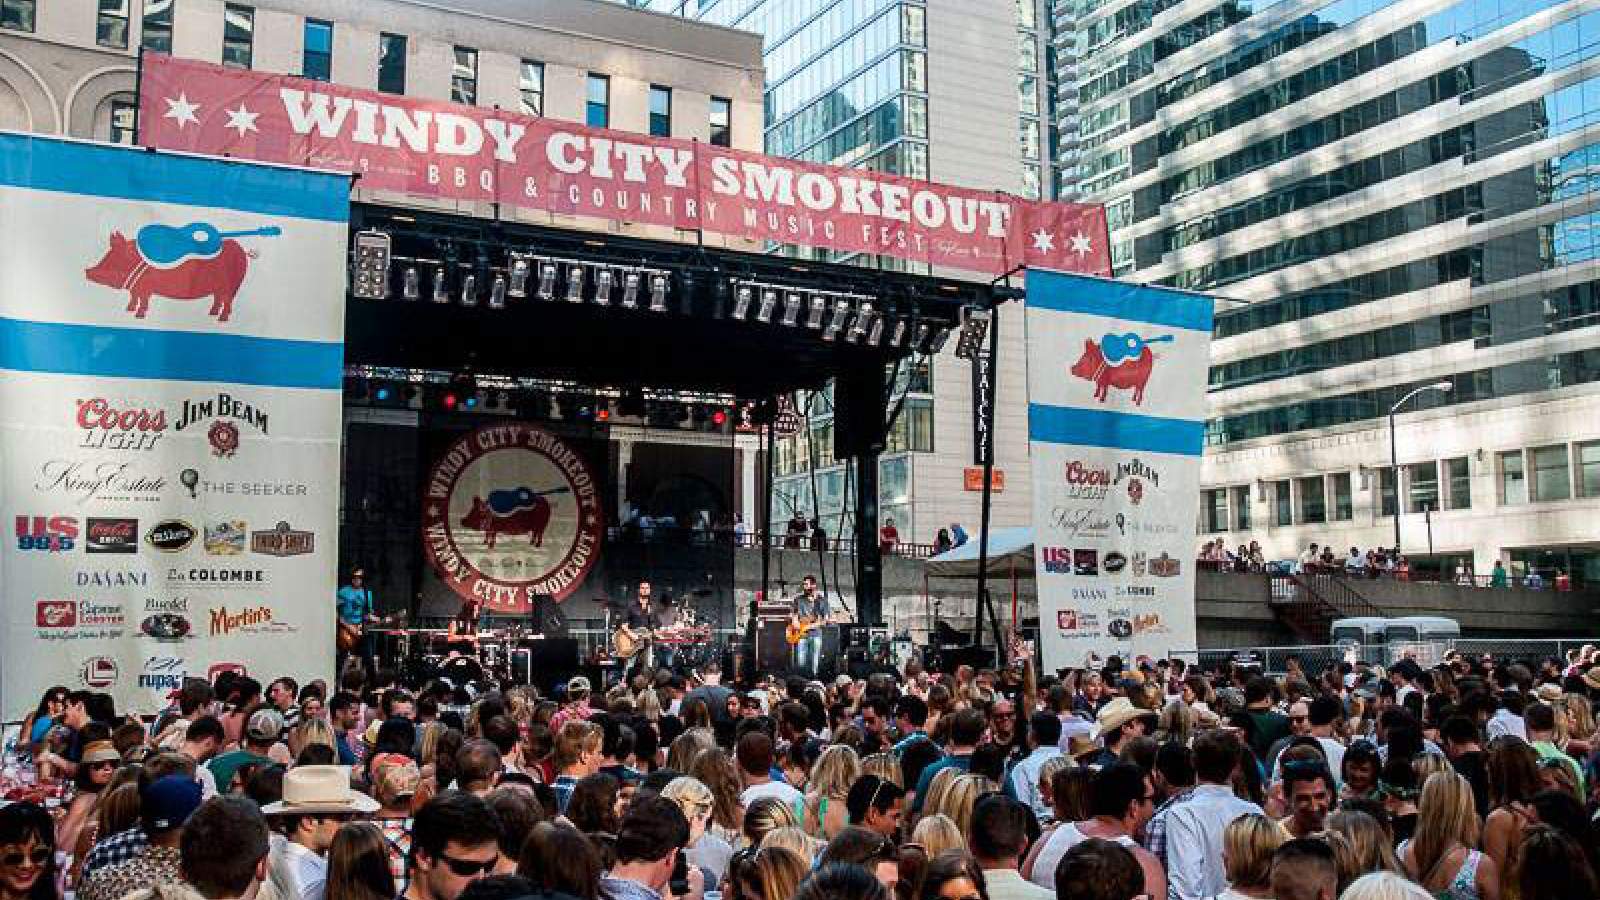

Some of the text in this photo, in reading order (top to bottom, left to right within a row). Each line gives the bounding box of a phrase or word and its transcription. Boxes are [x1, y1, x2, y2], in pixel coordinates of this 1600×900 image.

[280, 88, 1011, 238] WINDY CITY SMOKEOUT
[427, 164, 494, 192] BBQ
[525, 176, 538, 197] &
[569, 184, 718, 223] COUNTRY
[743, 207, 835, 240] MUSIC
[863, 224, 923, 252] FEST
[76, 398, 168, 431] Coors
[176, 393, 269, 435] JIM BEAM
[79, 431, 163, 451] LIGHT
[430, 426, 597, 508] WINDY CITY SMOKEOUT
[202, 482, 308, 496] THE SEEKER
[15, 515, 79, 538] US
[77, 571, 147, 587] DASANI
[189, 569, 264, 582] COLOMBE
[424, 522, 471, 583] WINDY
[473, 579, 519, 606] CITY
[210, 606, 273, 637] Martin's
